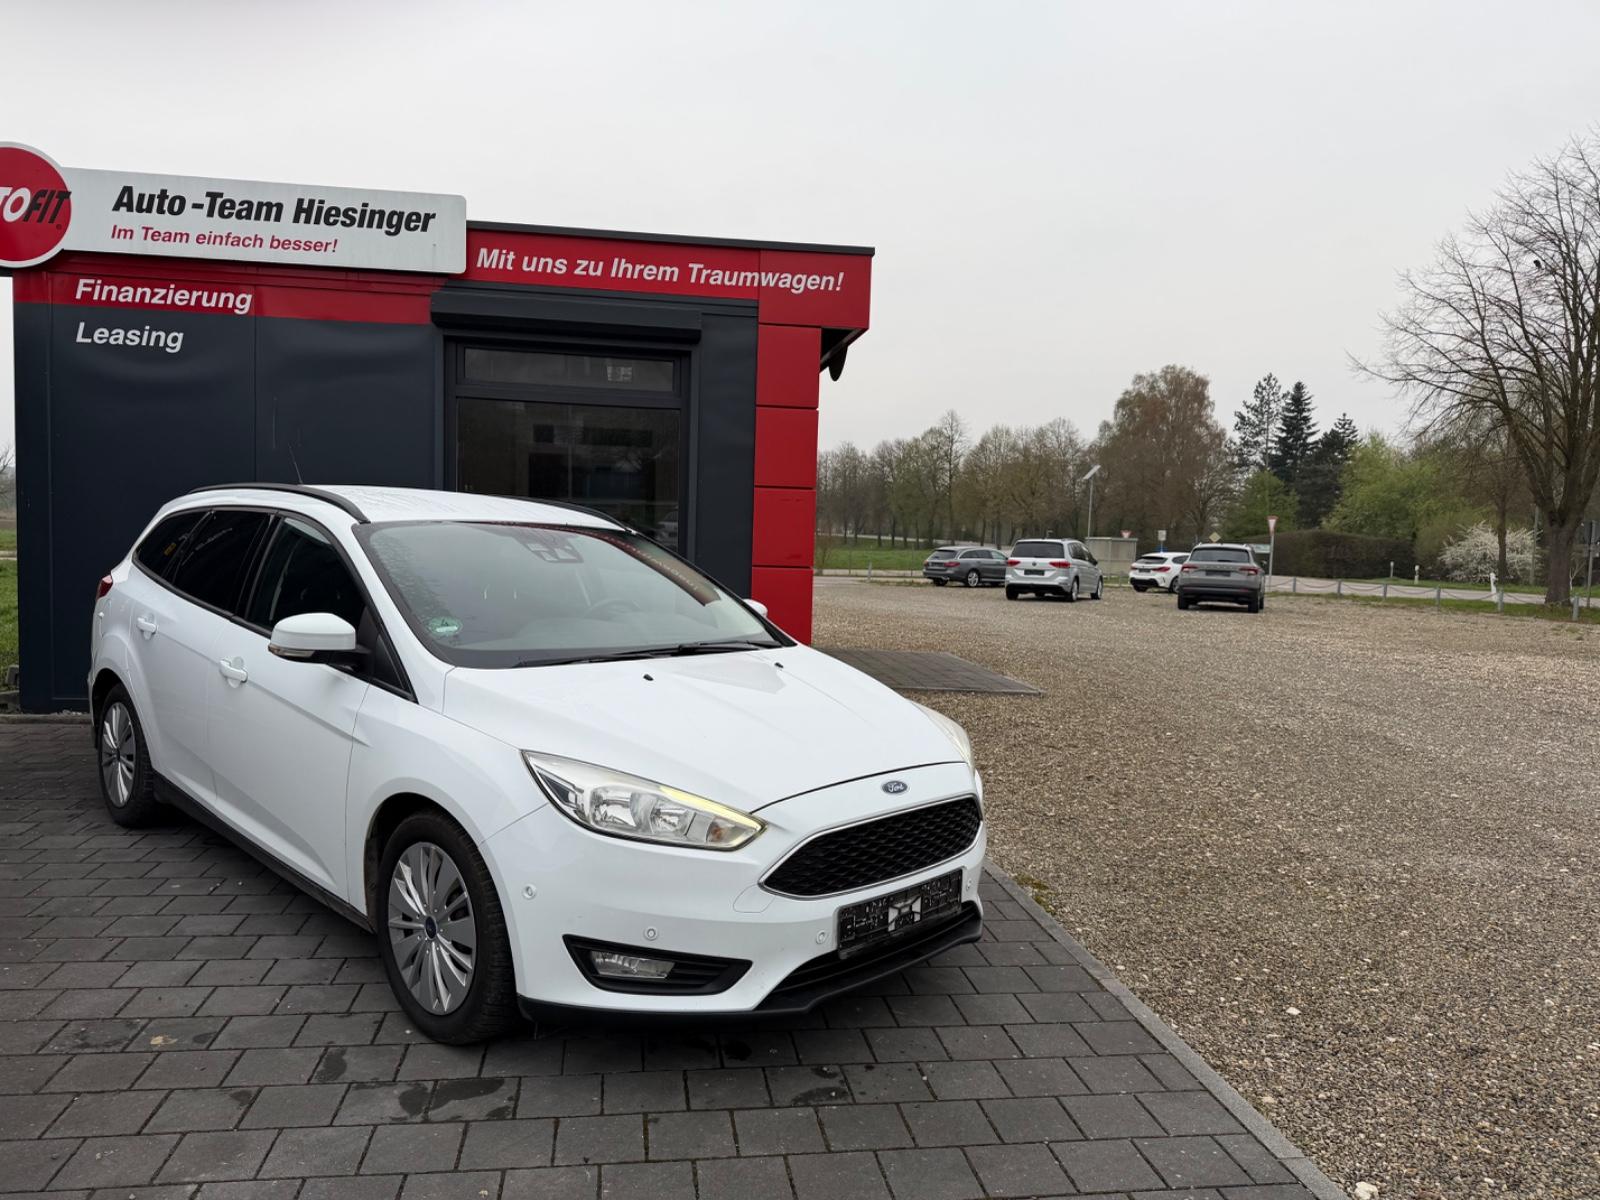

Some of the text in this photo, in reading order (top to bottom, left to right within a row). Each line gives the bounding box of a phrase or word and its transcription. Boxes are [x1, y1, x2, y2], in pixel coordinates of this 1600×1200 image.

[292, 198, 437, 237] Hiesinger
[111, 224, 338, 253] Im Team einfach besser!
[476, 248, 844, 294] Mit uns zu Ihrem Traumwagen!
[75, 278, 253, 315] Finanzierung
[76, 321, 184, 354] Leasing
